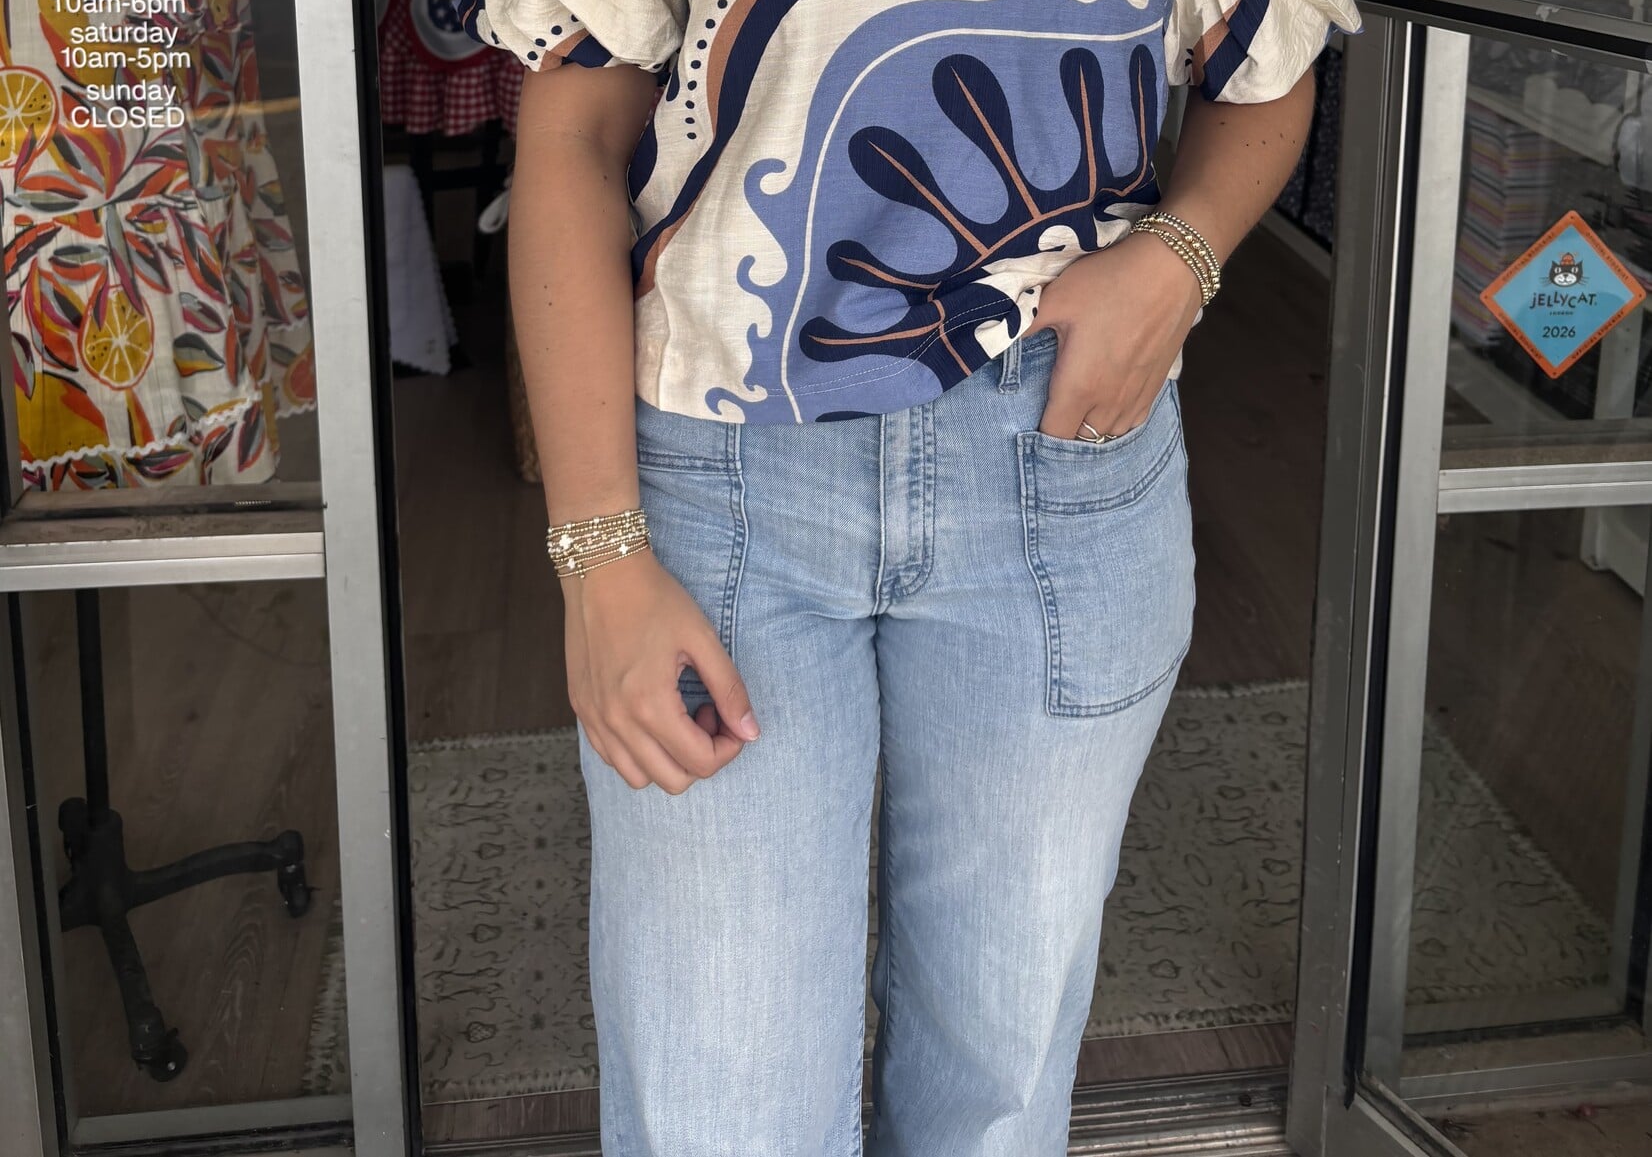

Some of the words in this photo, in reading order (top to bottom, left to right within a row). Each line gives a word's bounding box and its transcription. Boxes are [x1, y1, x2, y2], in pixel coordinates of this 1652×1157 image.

[70, 22, 178, 48] saturday
[61, 47, 191, 73] 10am-5pm
[86, 80, 177, 105] sunday
[71, 106, 185, 129] CLOSED
[1542, 325, 1576, 338] 2026
